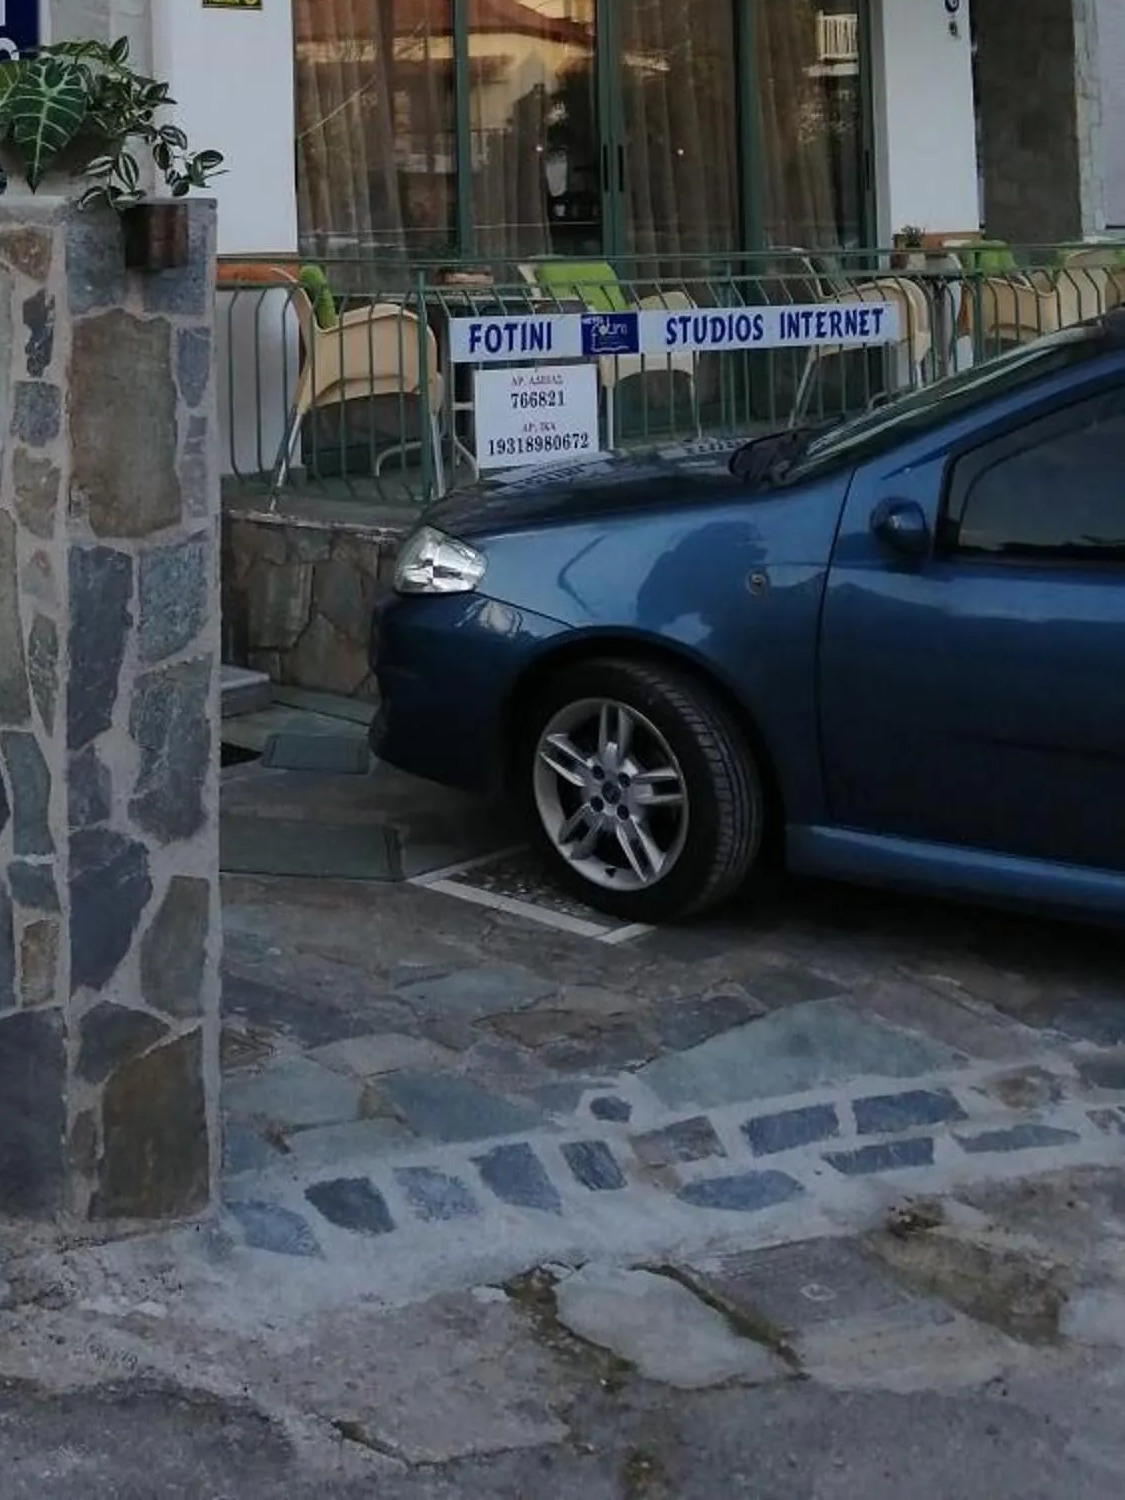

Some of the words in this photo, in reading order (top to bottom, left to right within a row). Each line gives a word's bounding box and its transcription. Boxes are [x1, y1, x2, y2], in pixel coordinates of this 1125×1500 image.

[468, 321, 553, 353] FOTINI
[665, 313, 764, 345] STUDIOS
[779, 307, 885, 340] INTERNET
[510, 389, 565, 409] 766821
[489, 432, 589, 456] 19318980672
